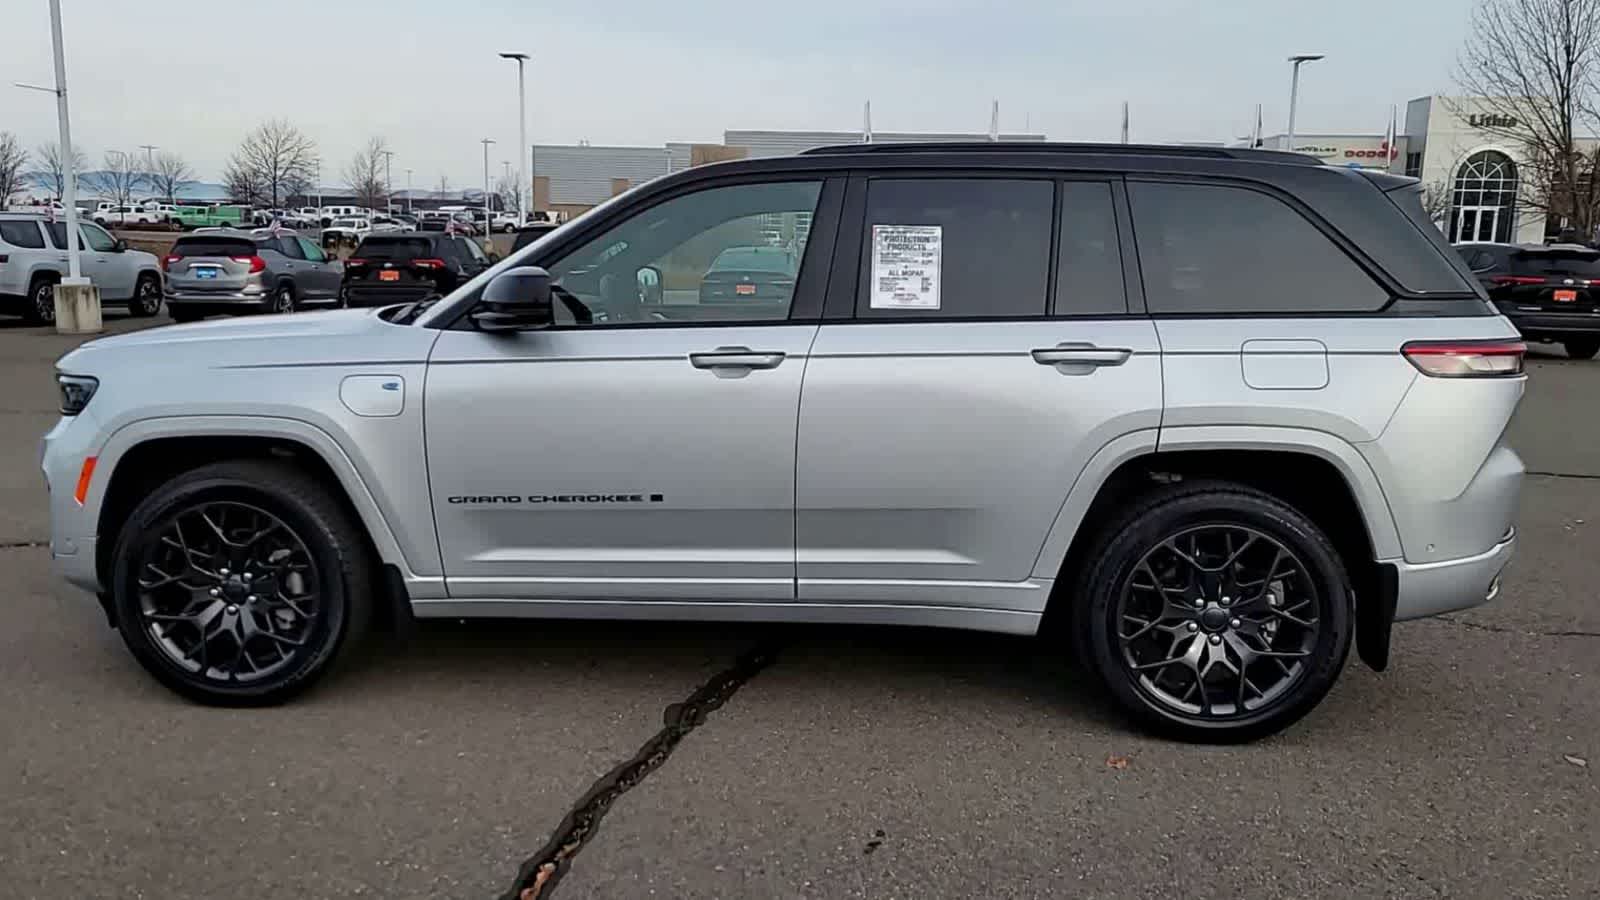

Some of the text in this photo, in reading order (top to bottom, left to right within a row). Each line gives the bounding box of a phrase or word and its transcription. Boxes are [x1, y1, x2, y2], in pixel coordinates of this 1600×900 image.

[1470, 114, 1517, 127] Lithia
[1344, 150, 1394, 158] DODG
[884, 235, 930, 243] PROTECTION
[888, 243, 927, 251] PRODUCTS
[448, 495, 642, 504] GRAND CHEROKEE
